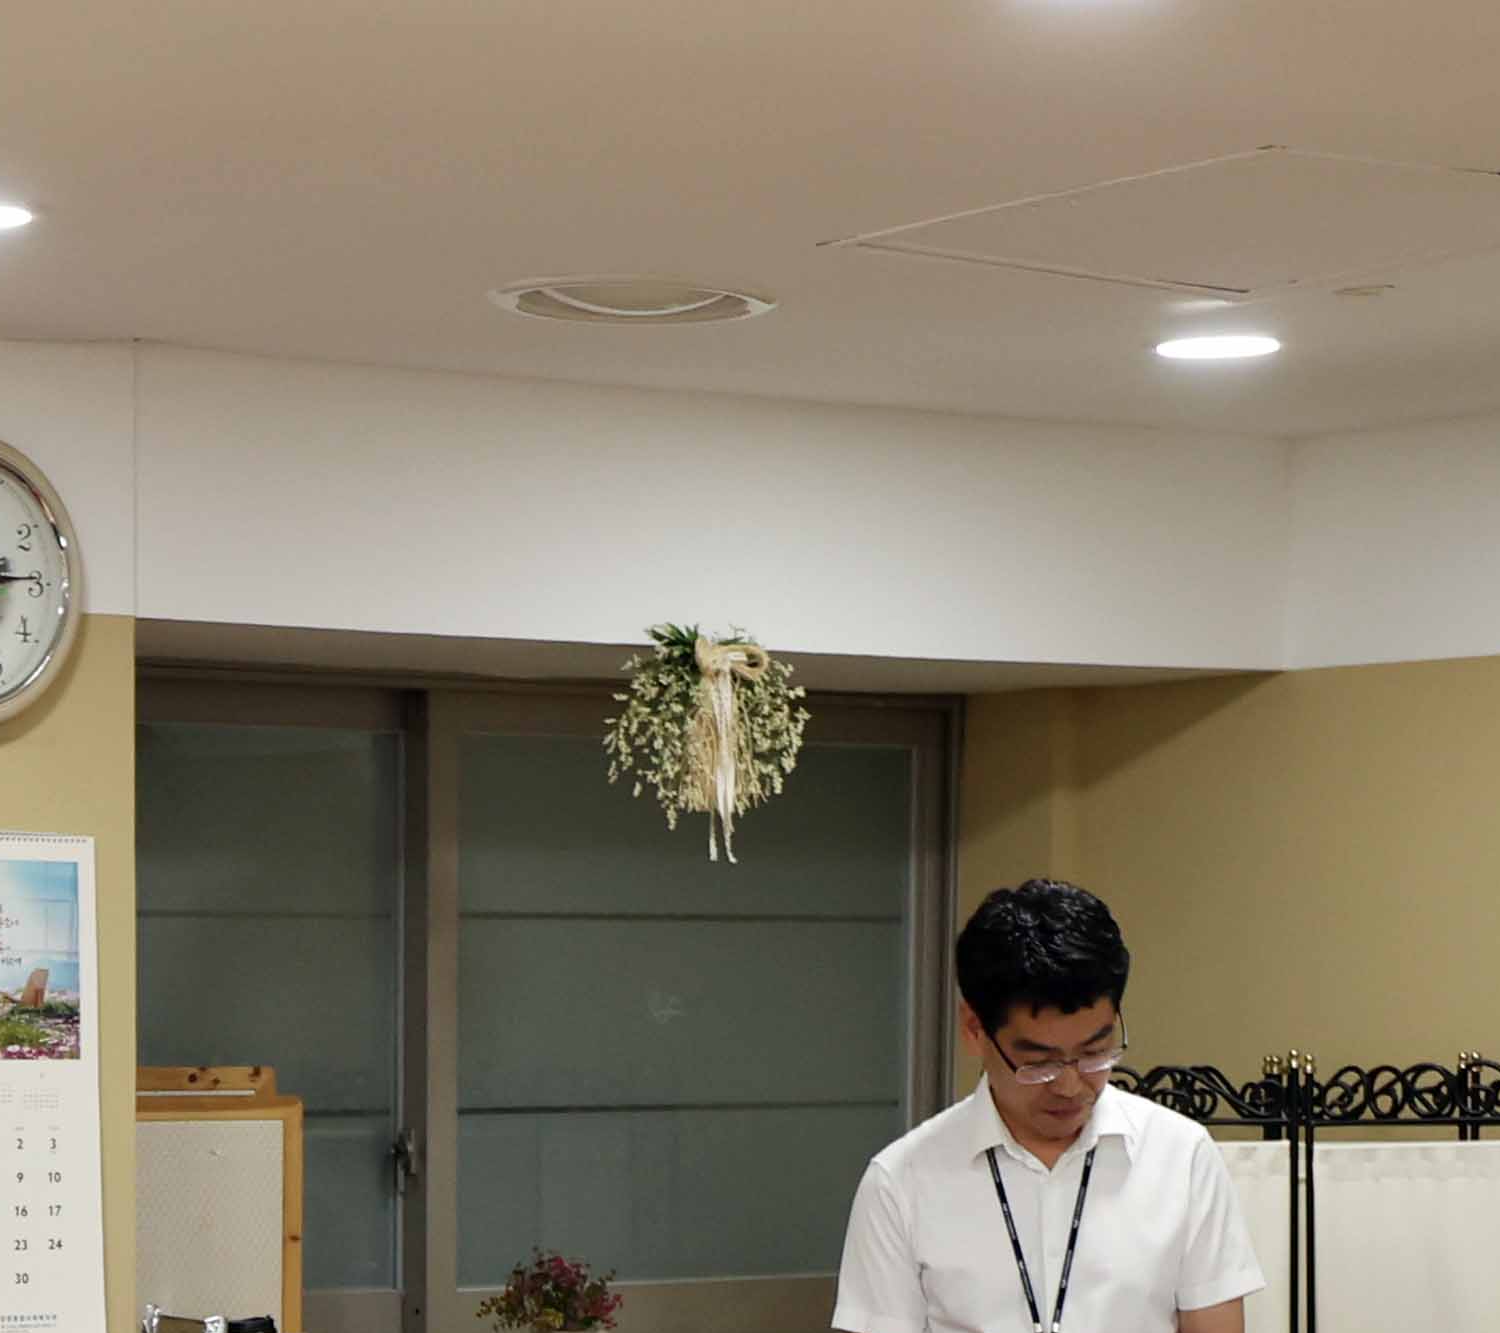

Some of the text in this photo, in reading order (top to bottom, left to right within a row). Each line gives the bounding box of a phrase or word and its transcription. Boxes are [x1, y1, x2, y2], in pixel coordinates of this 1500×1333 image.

[16, 523, 32, 552] 2
[27, 570, 44, 598] 3
[15, 615, 32, 643] 4
[16, 1138, 24, 1150] 2
[49, 1138, 57, 1150] 3
[16, 1172, 24, 1183] 9
[48, 1171, 61, 1183] 10
[15, 1205, 28, 1217] 16
[49, 1205, 62, 1217] 17
[14, 1239, 28, 1251] 23
[48, 1239, 62, 1250] 24
[15, 1272, 29, 1284] 30
